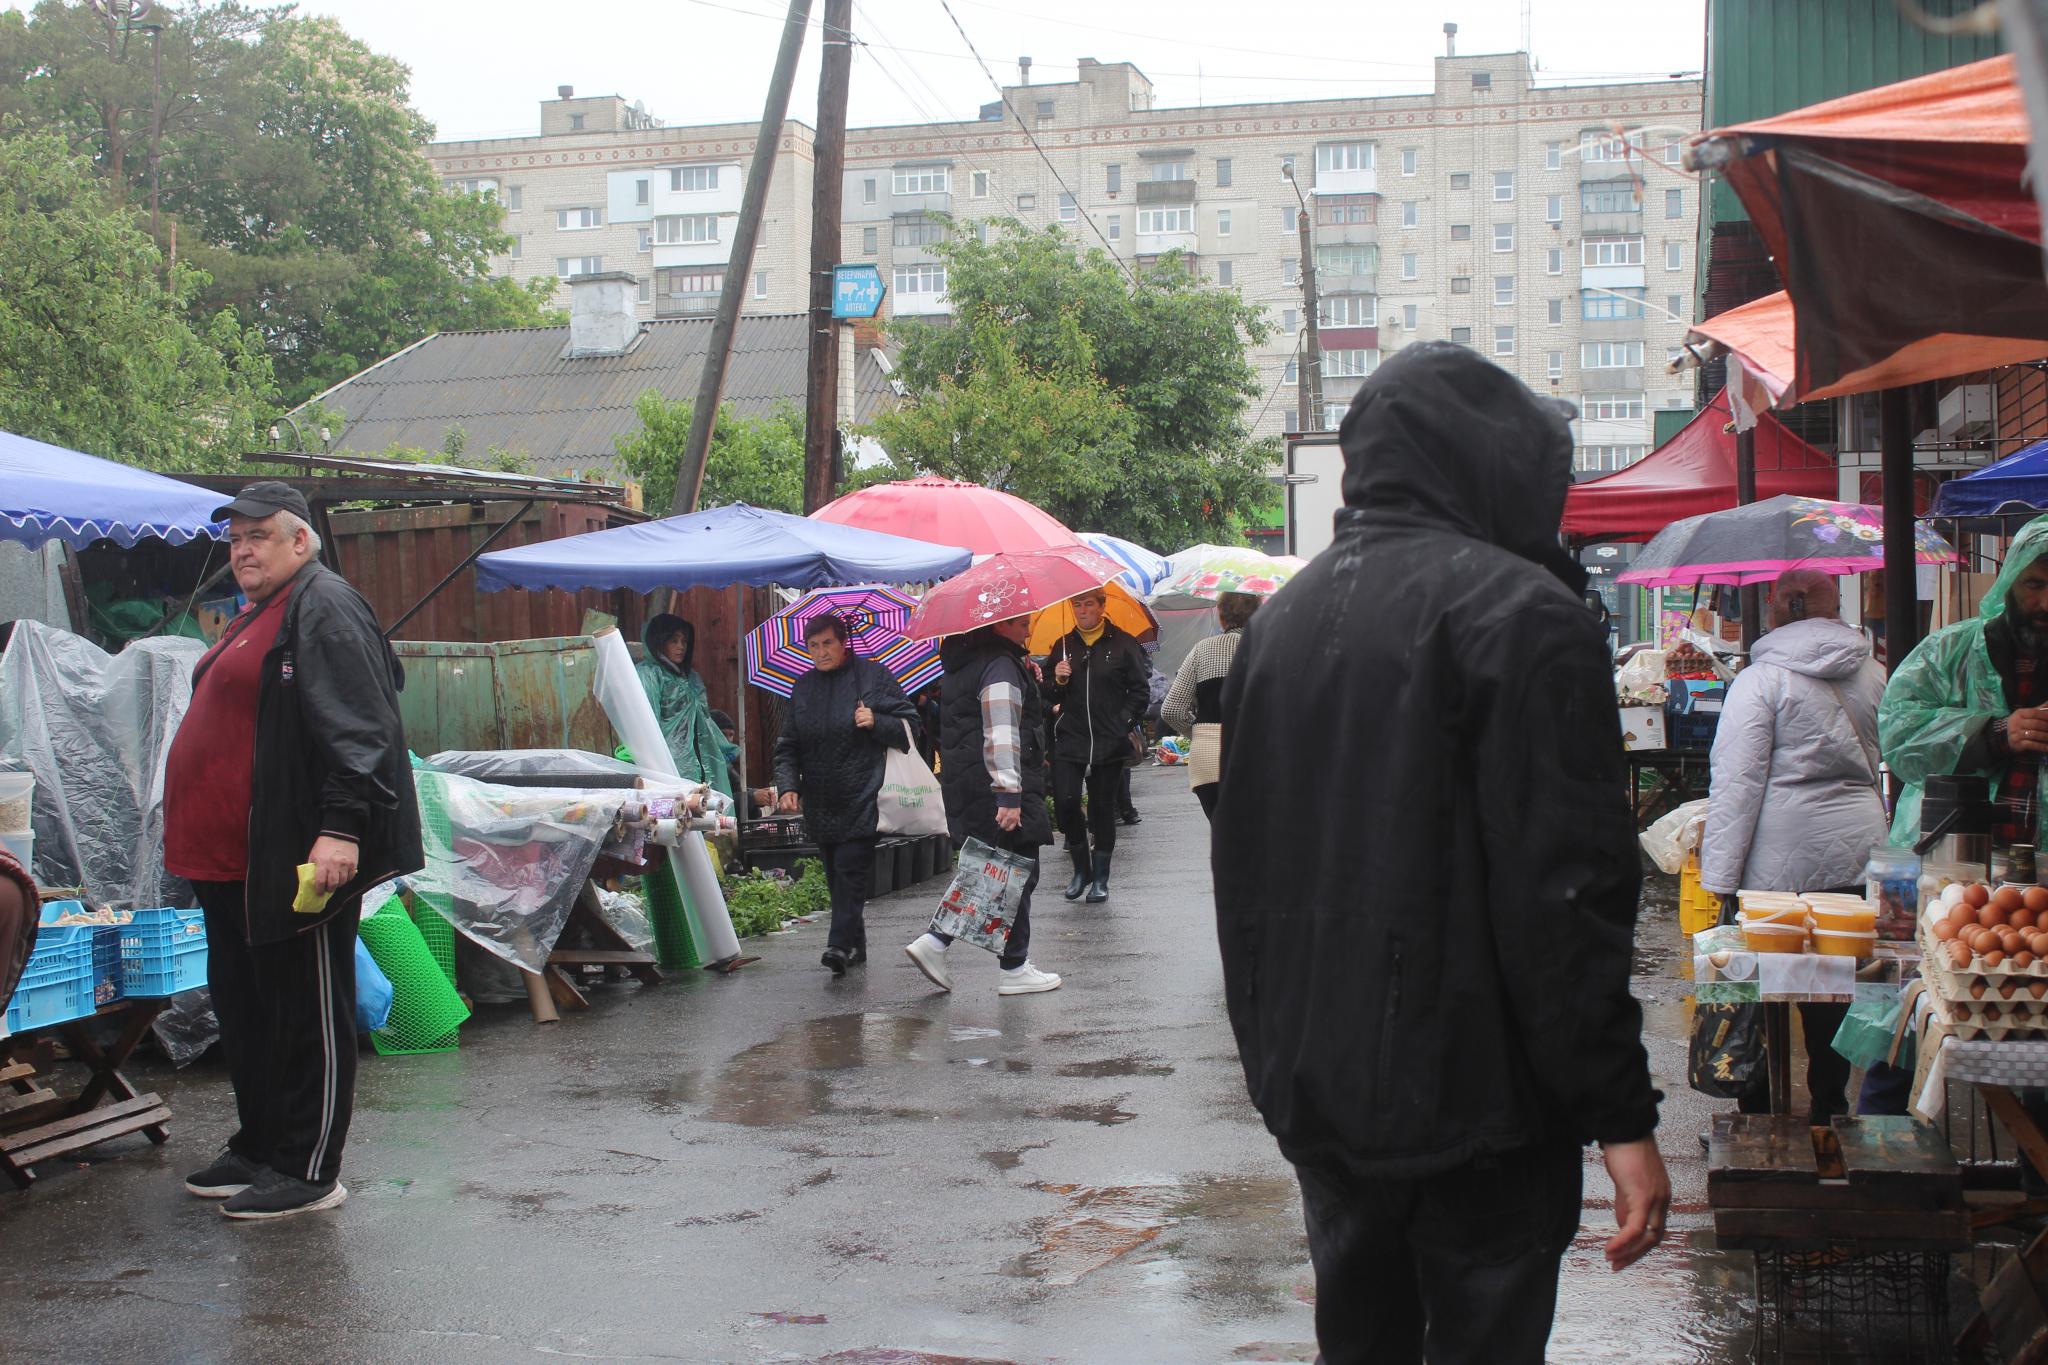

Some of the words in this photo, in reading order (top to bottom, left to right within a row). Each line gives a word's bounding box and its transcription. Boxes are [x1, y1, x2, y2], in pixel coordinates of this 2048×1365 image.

[837, 270, 877, 280] ВЕТЕРИНАРНА
[845, 302, 867, 312] АПТЕКА
[881, 783, 933, 796] ЖИТОМИЩИНА
[983, 862, 1008, 883] PARIS
